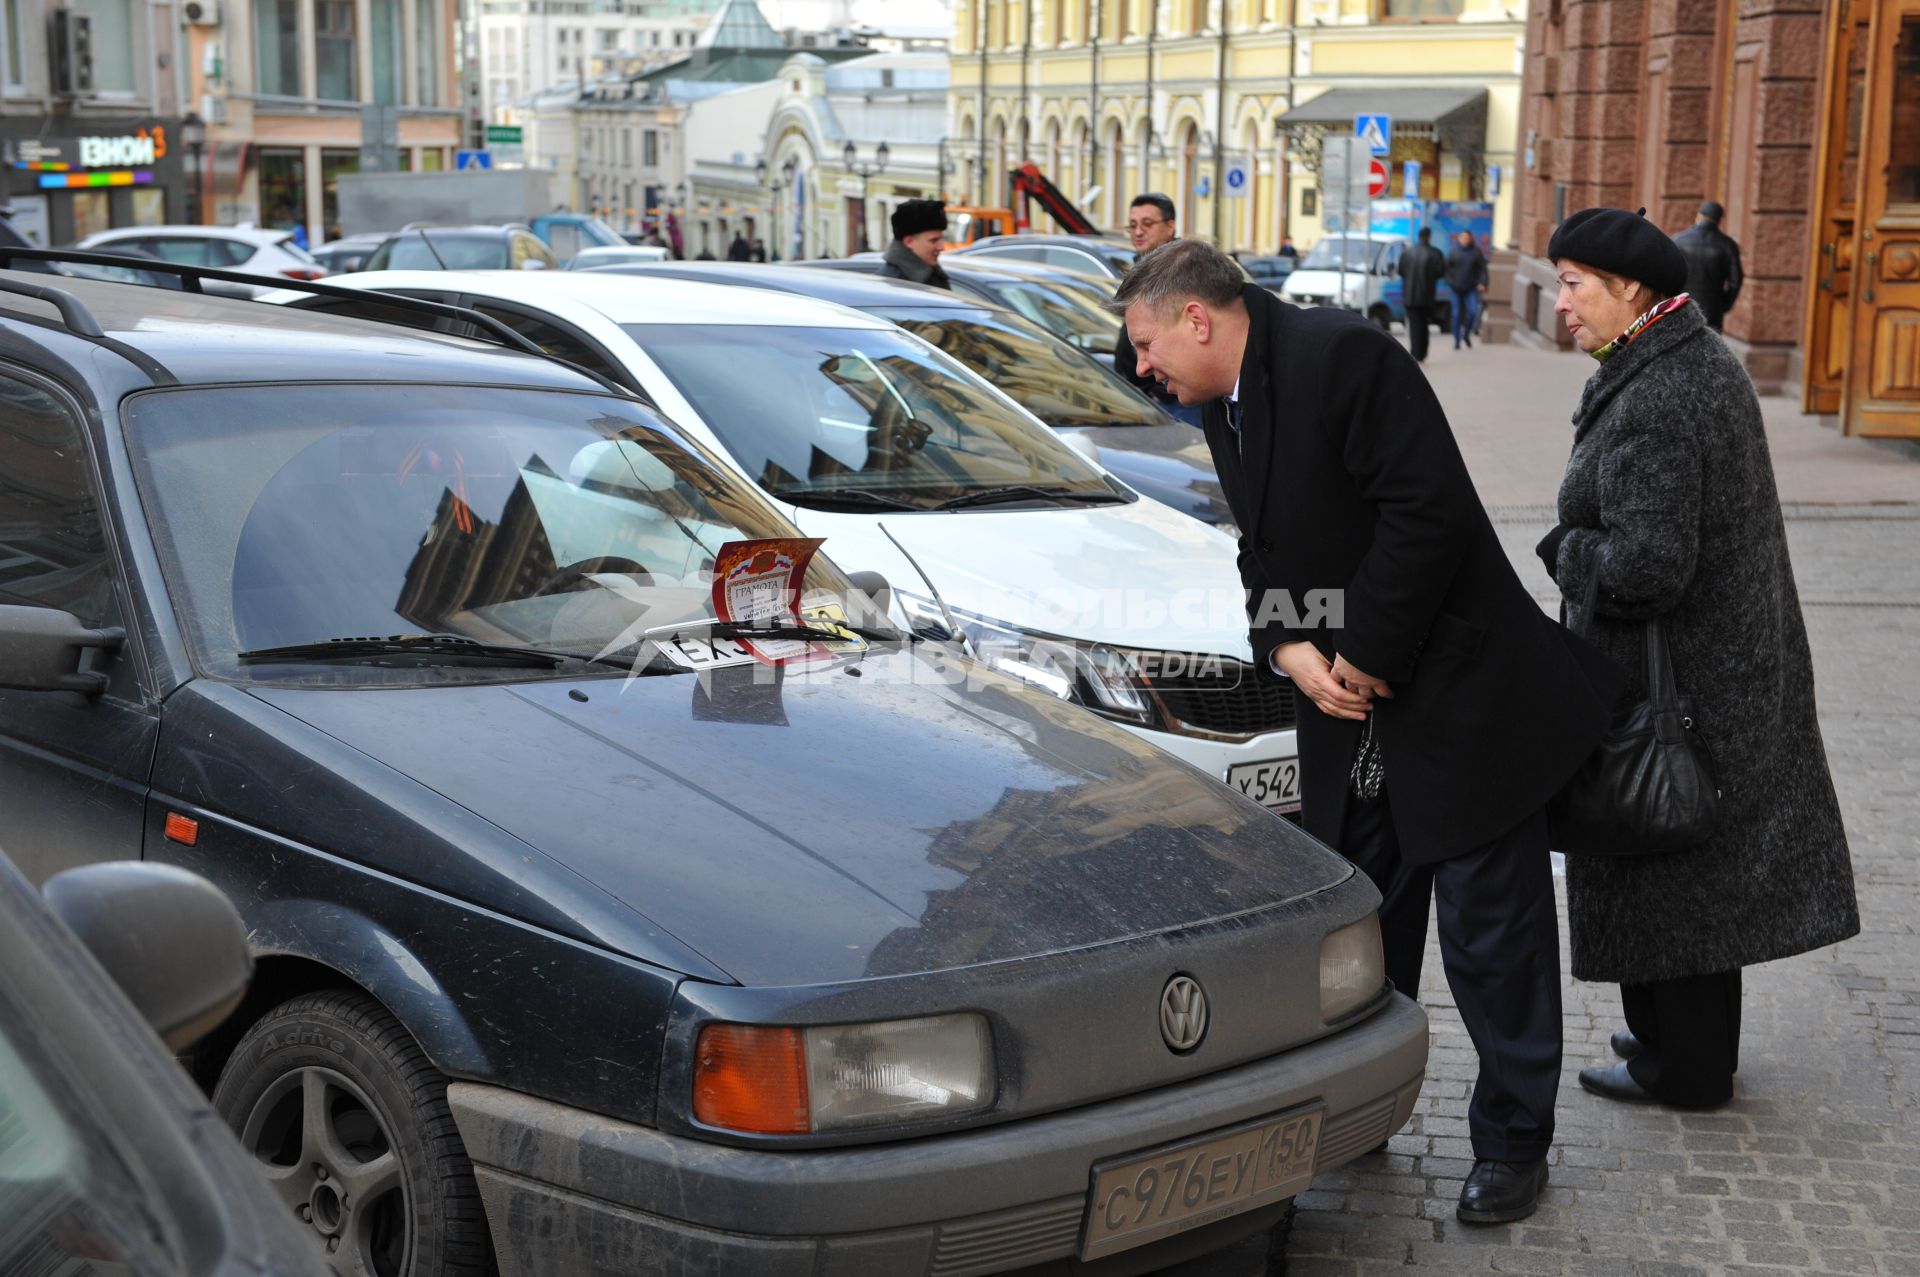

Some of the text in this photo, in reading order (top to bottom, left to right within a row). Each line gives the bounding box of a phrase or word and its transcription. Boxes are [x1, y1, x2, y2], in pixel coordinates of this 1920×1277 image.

[735, 580, 778, 598] ГРАМОТА
[259, 1025, 345, 1059] A.drive
[1263, 1118, 1312, 1168] 150
[1268, 1162, 1292, 1183] RUS
